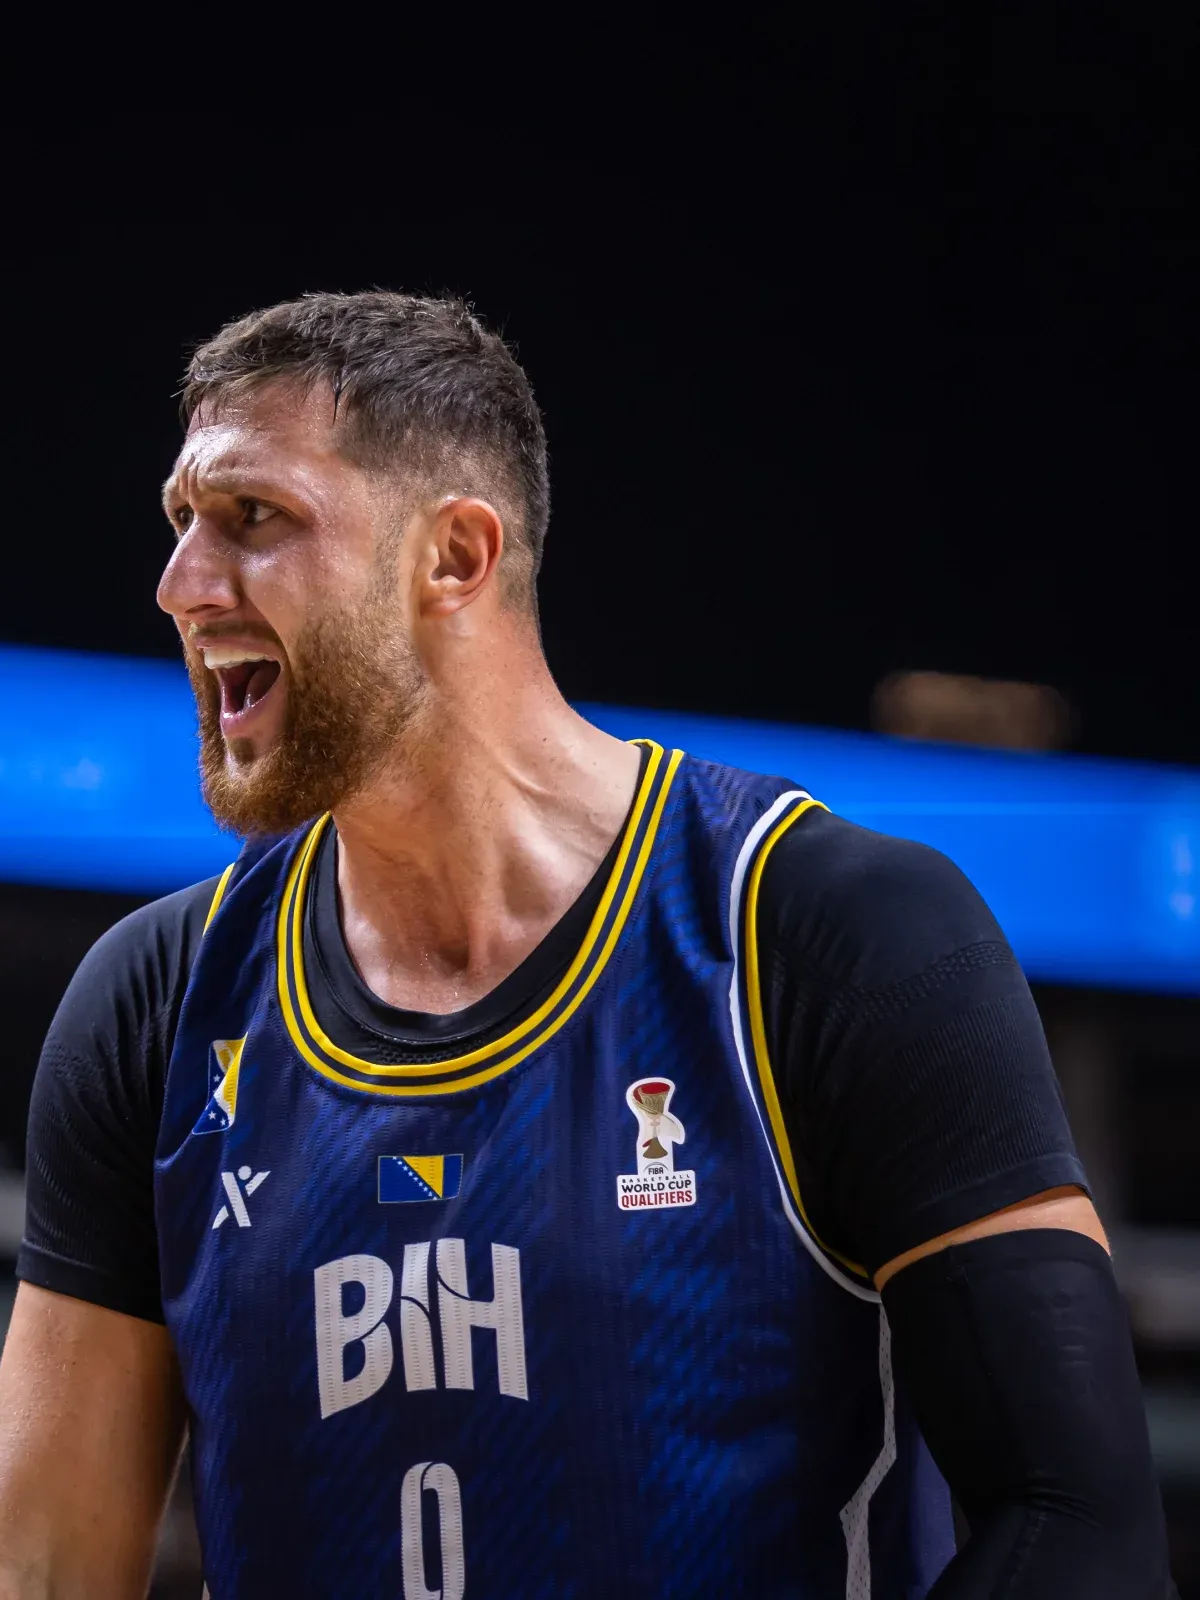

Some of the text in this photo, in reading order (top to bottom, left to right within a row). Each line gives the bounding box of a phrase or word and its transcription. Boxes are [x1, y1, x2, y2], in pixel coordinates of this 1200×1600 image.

[648, 1167, 664, 1175] FIBA
[622, 1174, 690, 1183] BASKETBALL
[621, 1179, 692, 1193] WORLD CUP
[621, 1190, 693, 1208] QUALIFIERS
[400, 1461, 465, 1600] 0
